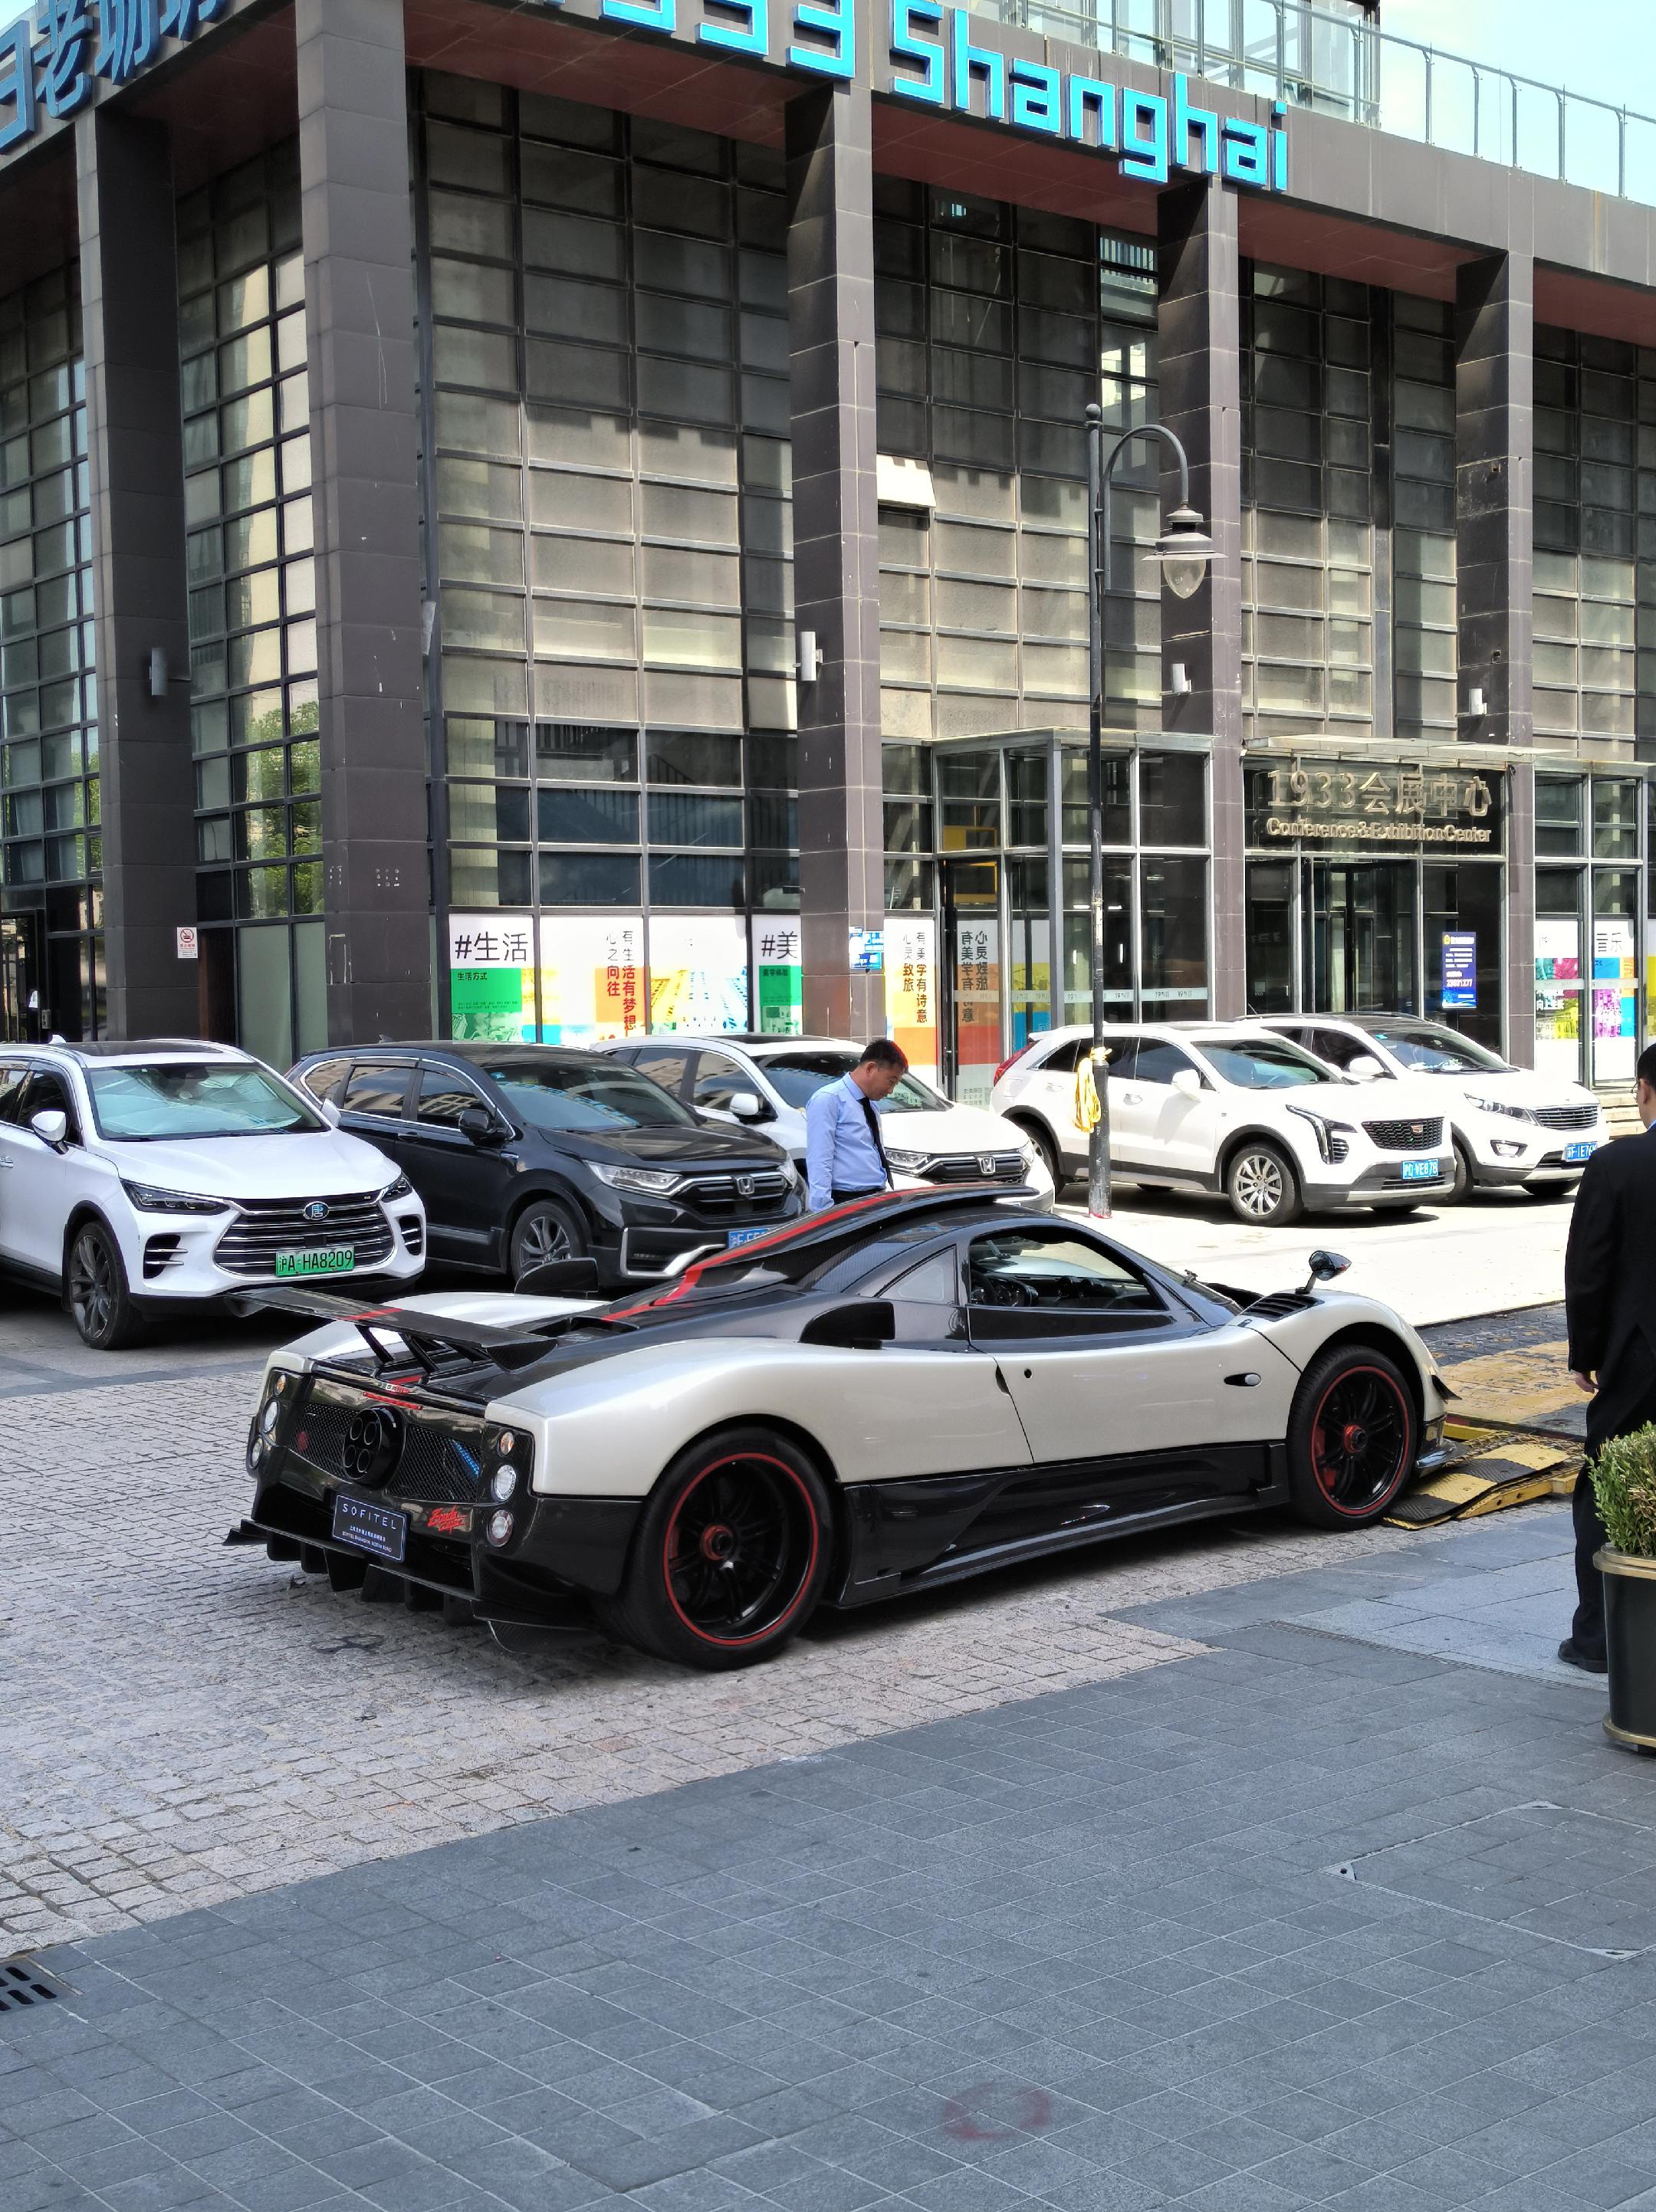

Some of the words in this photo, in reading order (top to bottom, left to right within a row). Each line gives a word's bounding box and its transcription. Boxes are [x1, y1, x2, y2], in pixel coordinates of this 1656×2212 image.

[890, 0, 1288, 192] Shanghai
[1267, 770, 1492, 816] 1933会展中心
[455, 931, 527, 961] #生活
[457, 972, 488, 981] 生活方式
[342, 1503, 396, 1531] SOFITEL
